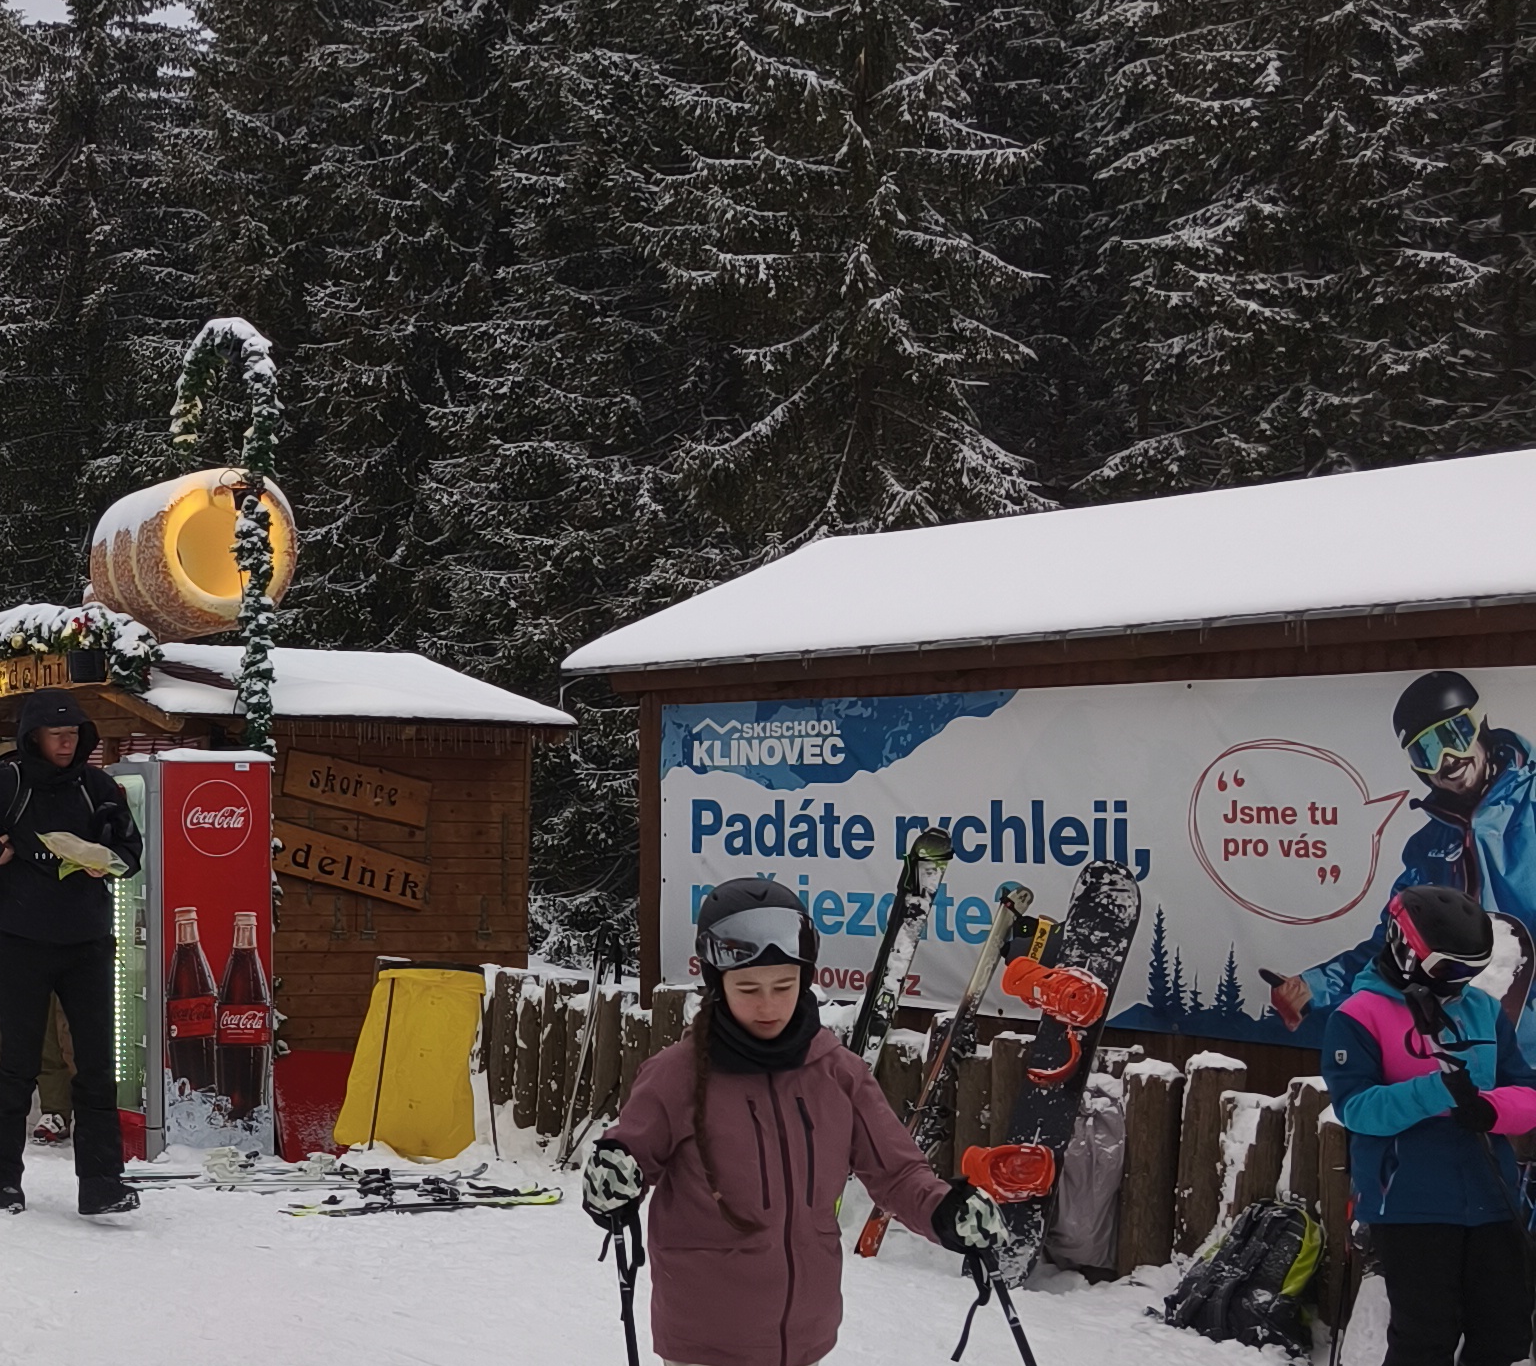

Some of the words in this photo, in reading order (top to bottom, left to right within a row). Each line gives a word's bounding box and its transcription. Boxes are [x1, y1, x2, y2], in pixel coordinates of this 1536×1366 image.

[742, 719, 842, 738] SKISCHOOL
[692, 732, 847, 767] KLÍNOVEC
[1222, 799, 1298, 825] Jsme
[1307, 801, 1339, 826] tu
[691, 798, 876, 861] Padáte
[1222, 837, 1269, 862] pro
[1278, 832, 1328, 859] vás
